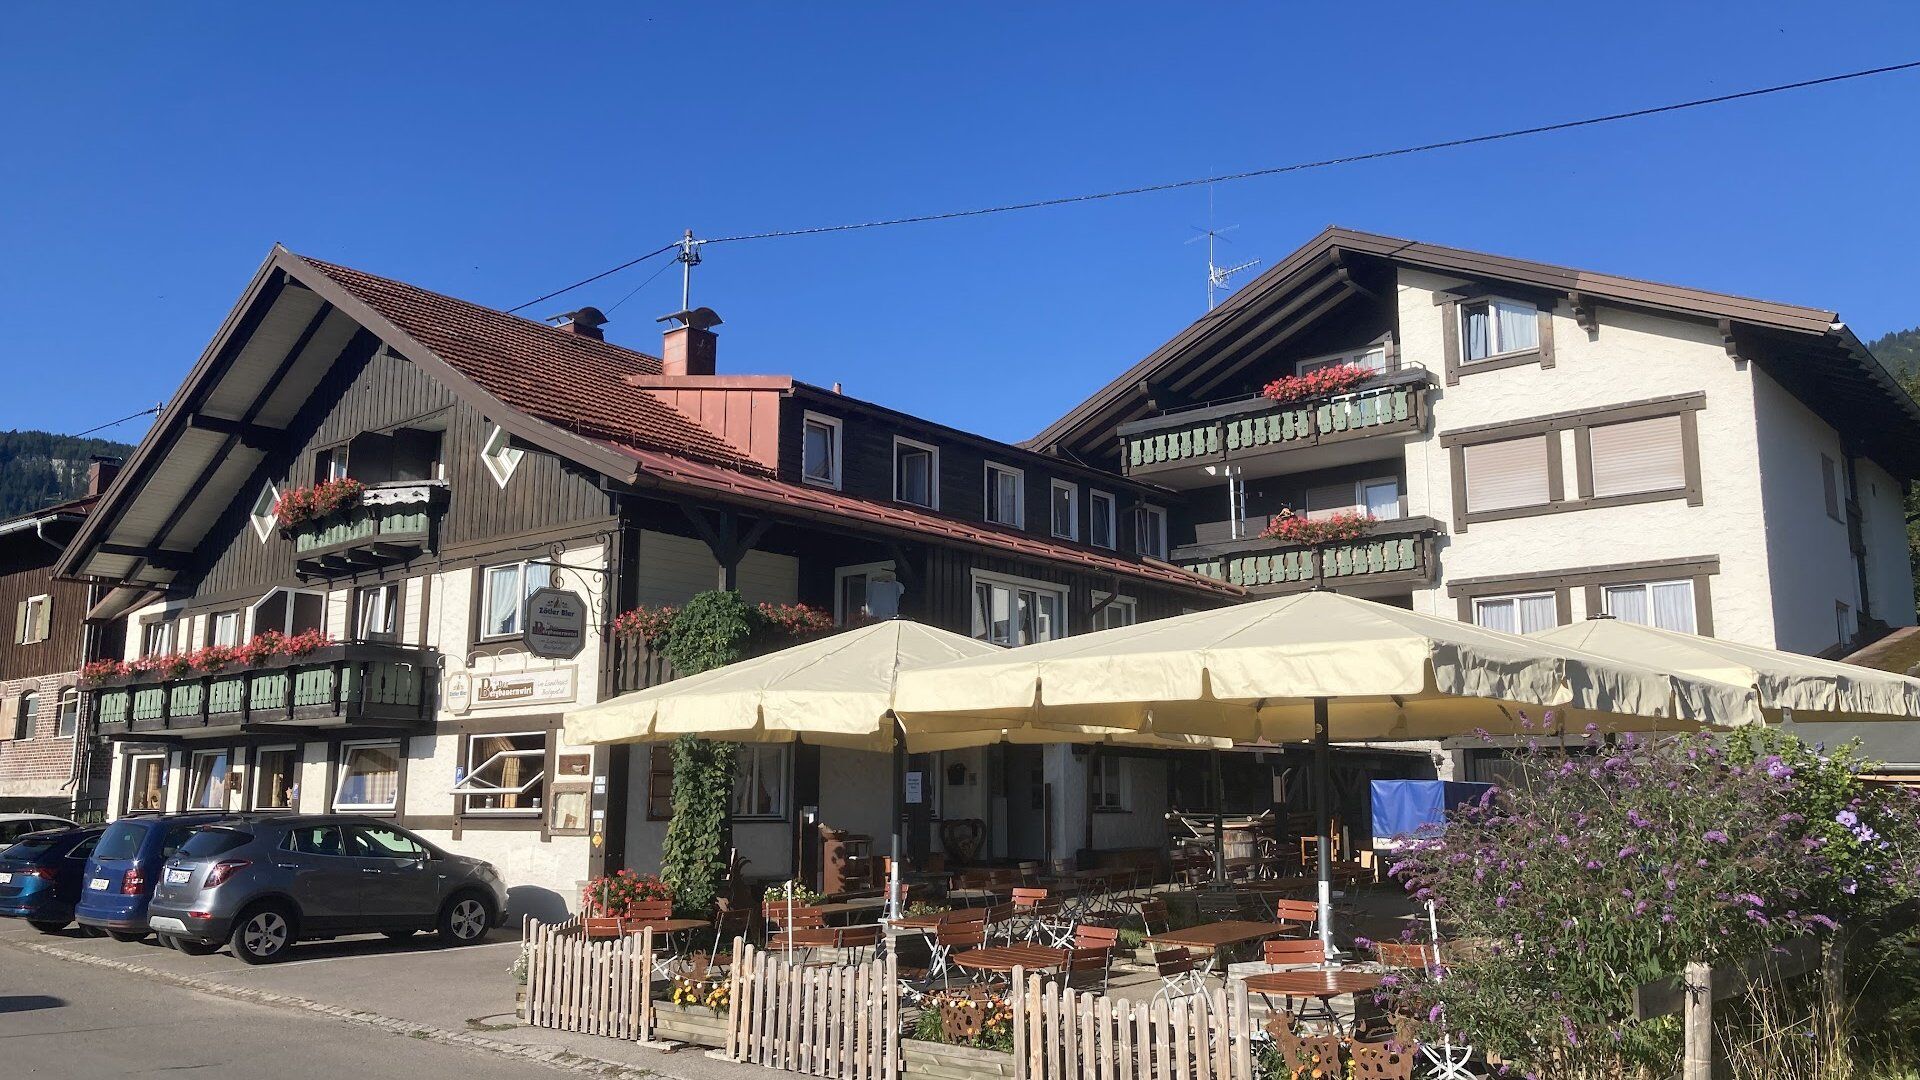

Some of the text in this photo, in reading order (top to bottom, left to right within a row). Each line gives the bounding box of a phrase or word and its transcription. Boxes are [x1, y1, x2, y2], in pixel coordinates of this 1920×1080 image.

[561, 609, 575, 617] Bier
[498, 680, 509, 688] Der
[480, 678, 532, 699] Bergbauernwirt
